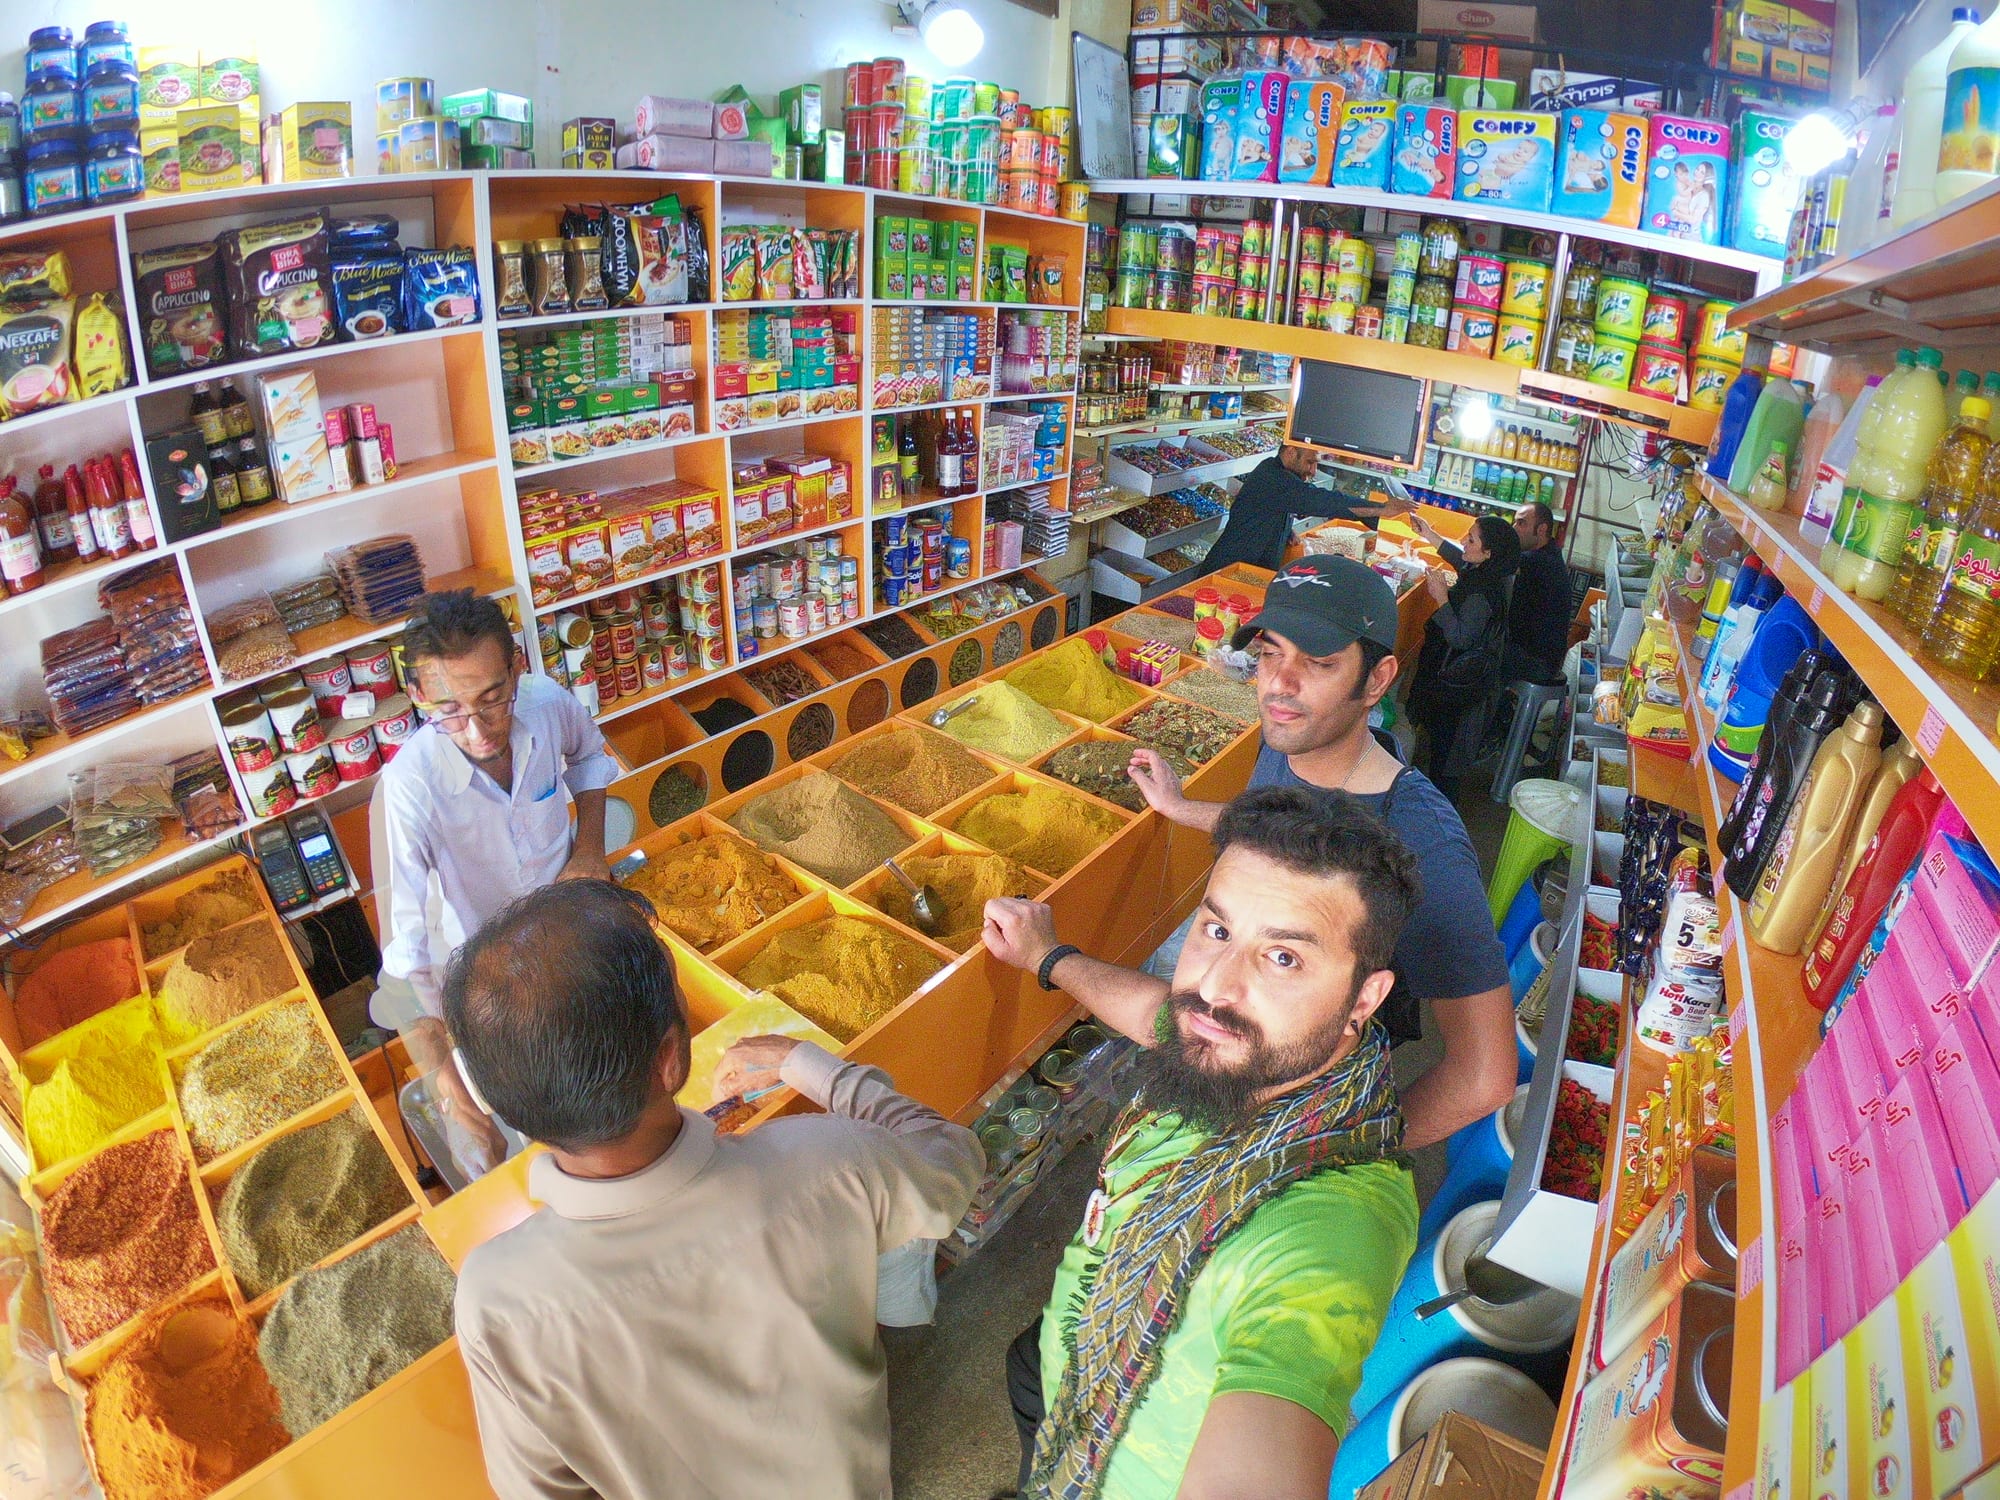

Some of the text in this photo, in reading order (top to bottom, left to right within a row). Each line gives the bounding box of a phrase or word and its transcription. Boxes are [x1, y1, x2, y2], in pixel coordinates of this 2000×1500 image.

[1460, 12, 1490, 24] Shan
[1209, 86, 1238, 95] CONFY
[1268, 81, 1280, 115] CONFY
[1319, 92, 1332, 127] CONFY
[1349, 106, 1386, 115] CONFY
[1473, 120, 1536, 134] CONFY
[1663, 124, 1720, 144] CONFY
[1441, 116, 1452, 155] CONFY
[1622, 127, 1642, 182] CONFY
[1656, 215, 1666, 224] 4
[273, 249, 300, 261] TORA
[409, 252, 445, 268] Blue
[613, 215, 628, 290] MAHMOOD
[276, 257, 301, 271] BIKA
[167, 271, 193, 283] TORA
[333, 263, 369, 283] Blue
[1476, 271, 1500, 283] TANG
[170, 278, 194, 290] BIKA
[1514, 280, 1544, 299] Tri-C
[152, 289, 211, 315] CAPPUCCINO
[1601, 296, 1632, 316] Tri-C
[1645, 311, 1673, 329] Tri-C
[1468, 323, 1493, 335] TANG
[1592, 351, 1625, 371] Tri-C
[1648, 364, 1677, 384] Tri-C
[1695, 374, 1727, 394] Tri-C
[692, 502, 711, 511] National
[652, 511, 673, 520] National
[620, 523, 642, 532] National
[577, 533, 600, 543] National
[534, 545, 558, 556] National
[1929, 852, 1947, 879] AREN
[1677, 922, 1696, 948] 5
[1687, 1006, 1707, 1016] Beef
